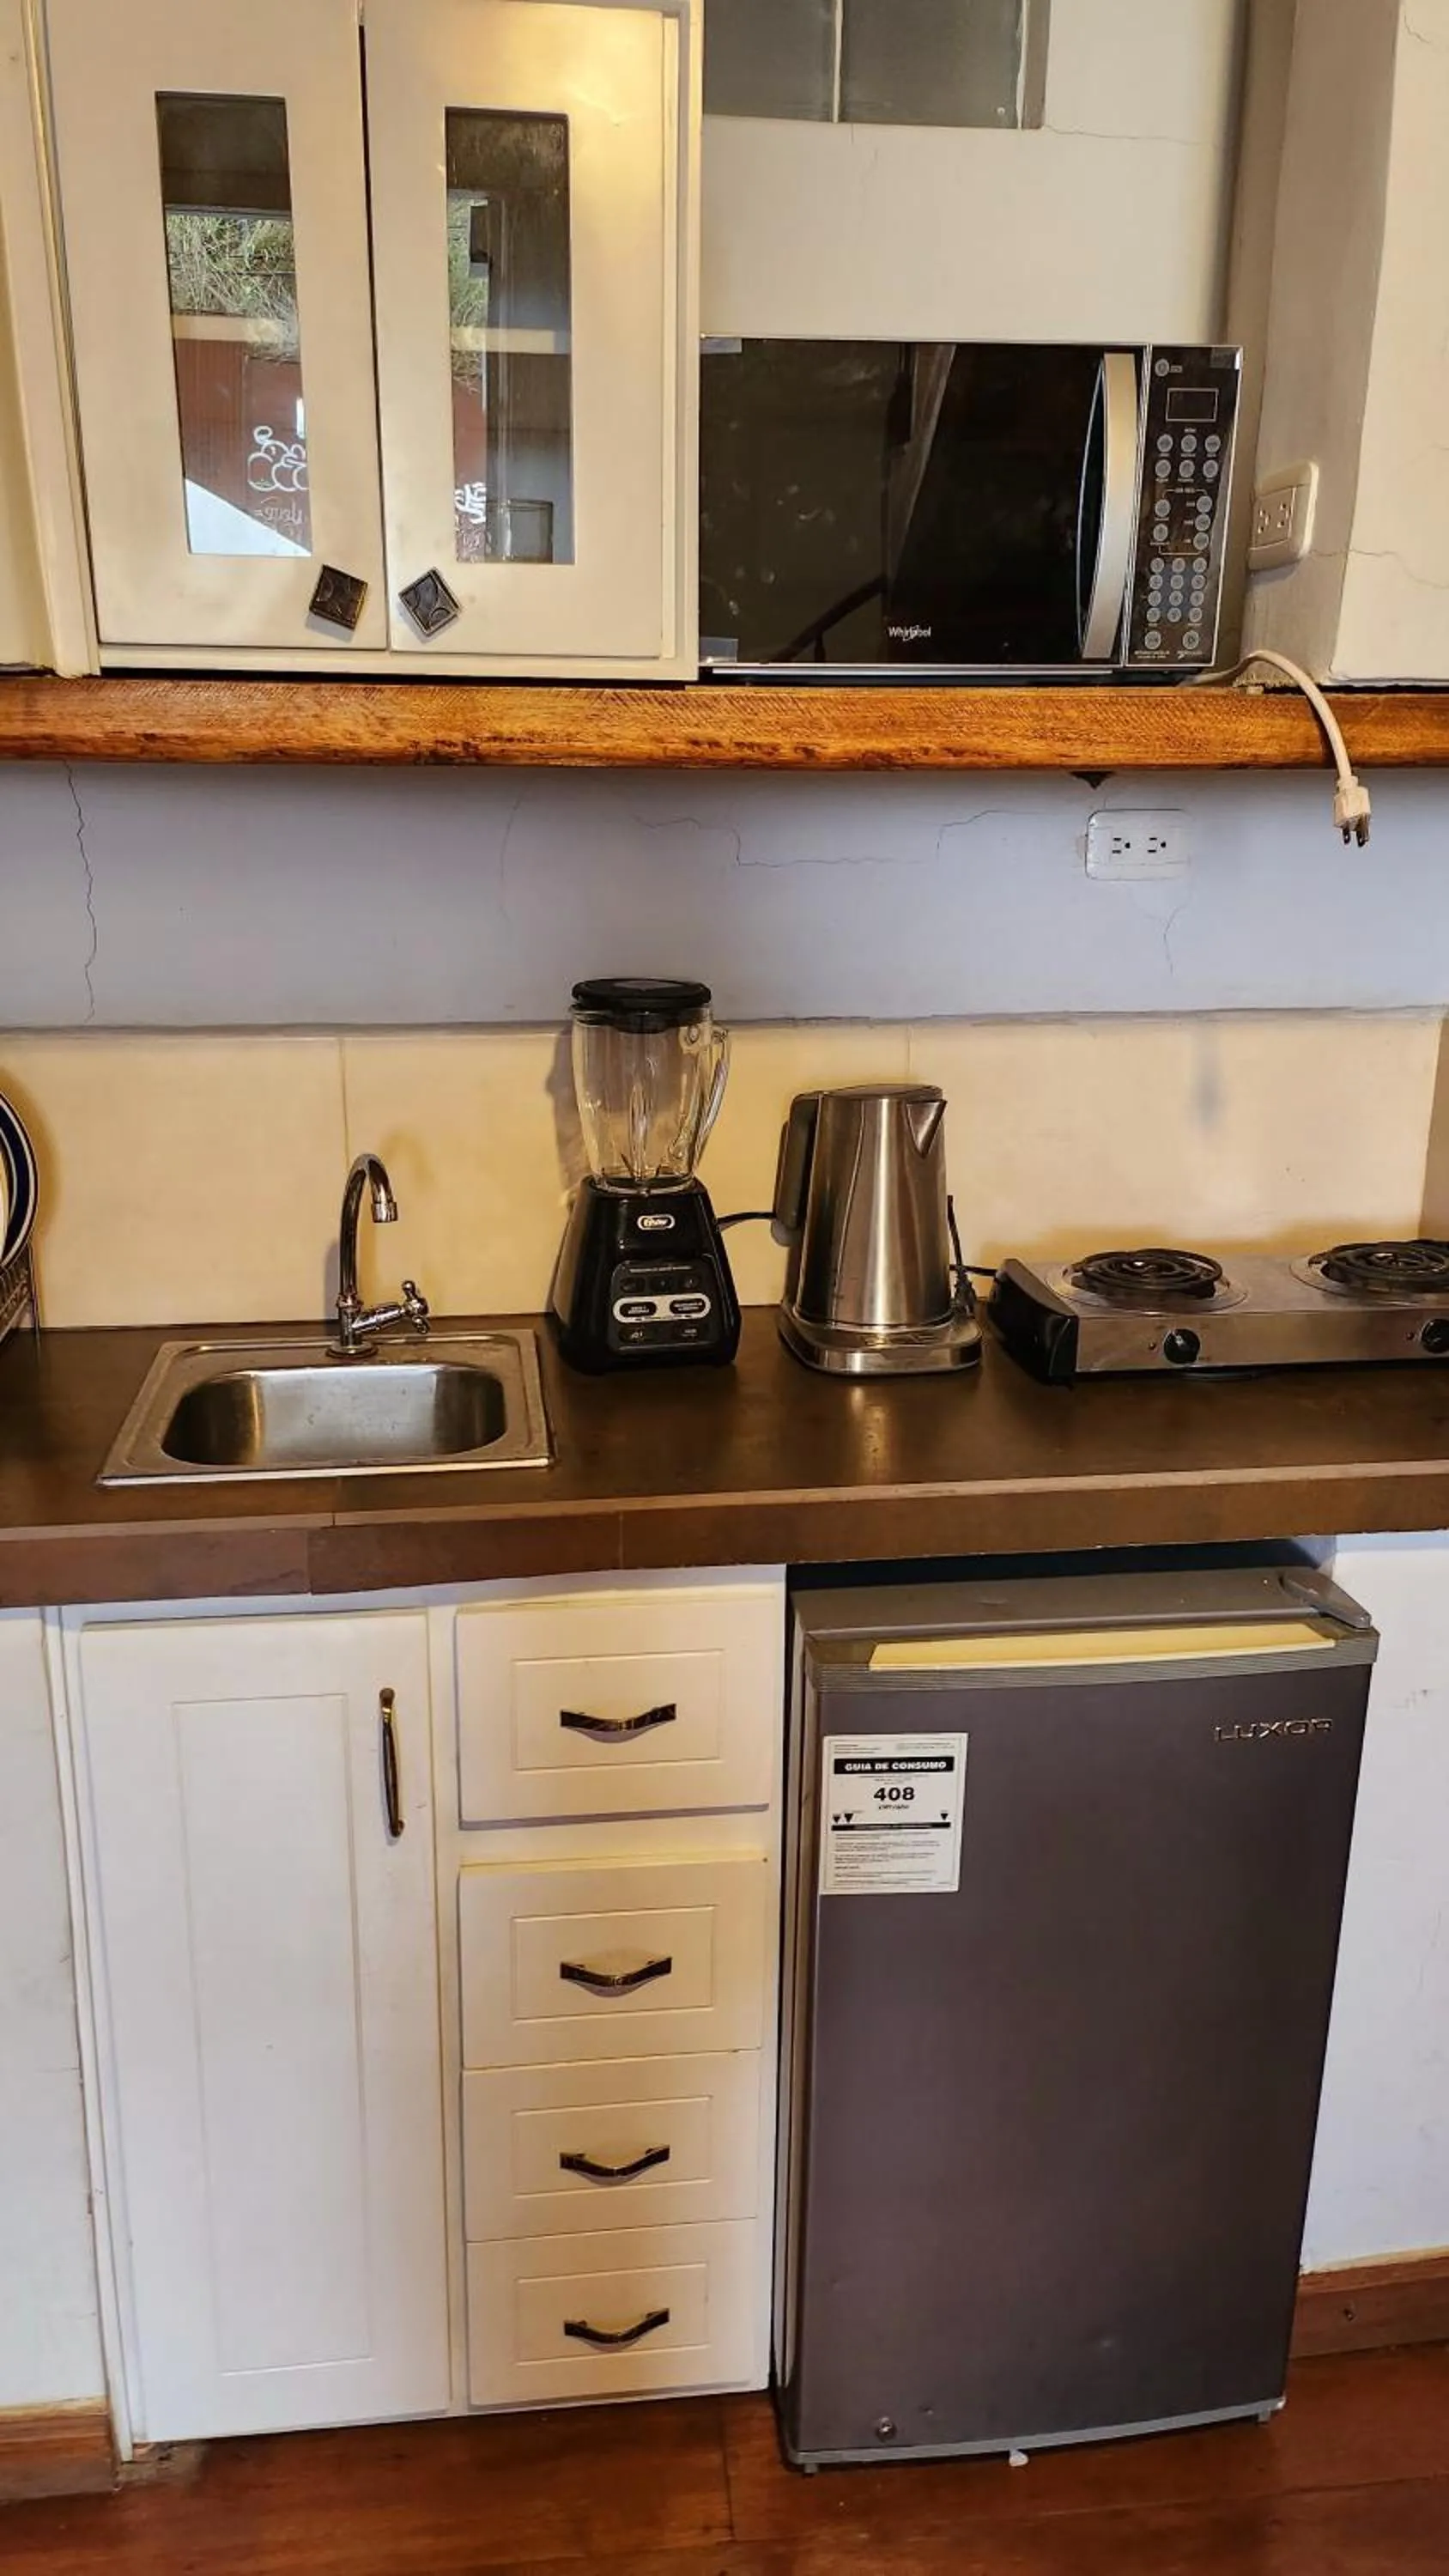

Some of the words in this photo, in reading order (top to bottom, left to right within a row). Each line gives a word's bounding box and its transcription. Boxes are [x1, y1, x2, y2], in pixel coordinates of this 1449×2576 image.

[888, 625, 931, 641] Whirlpool
[1215, 1718, 1332, 1741] LUXOR
[845, 1763, 871, 1771] GUIA
[875, 1762, 889, 1771] DE
[892, 1761, 947, 1771] CONSUMO
[873, 1787, 915, 1801] 408
